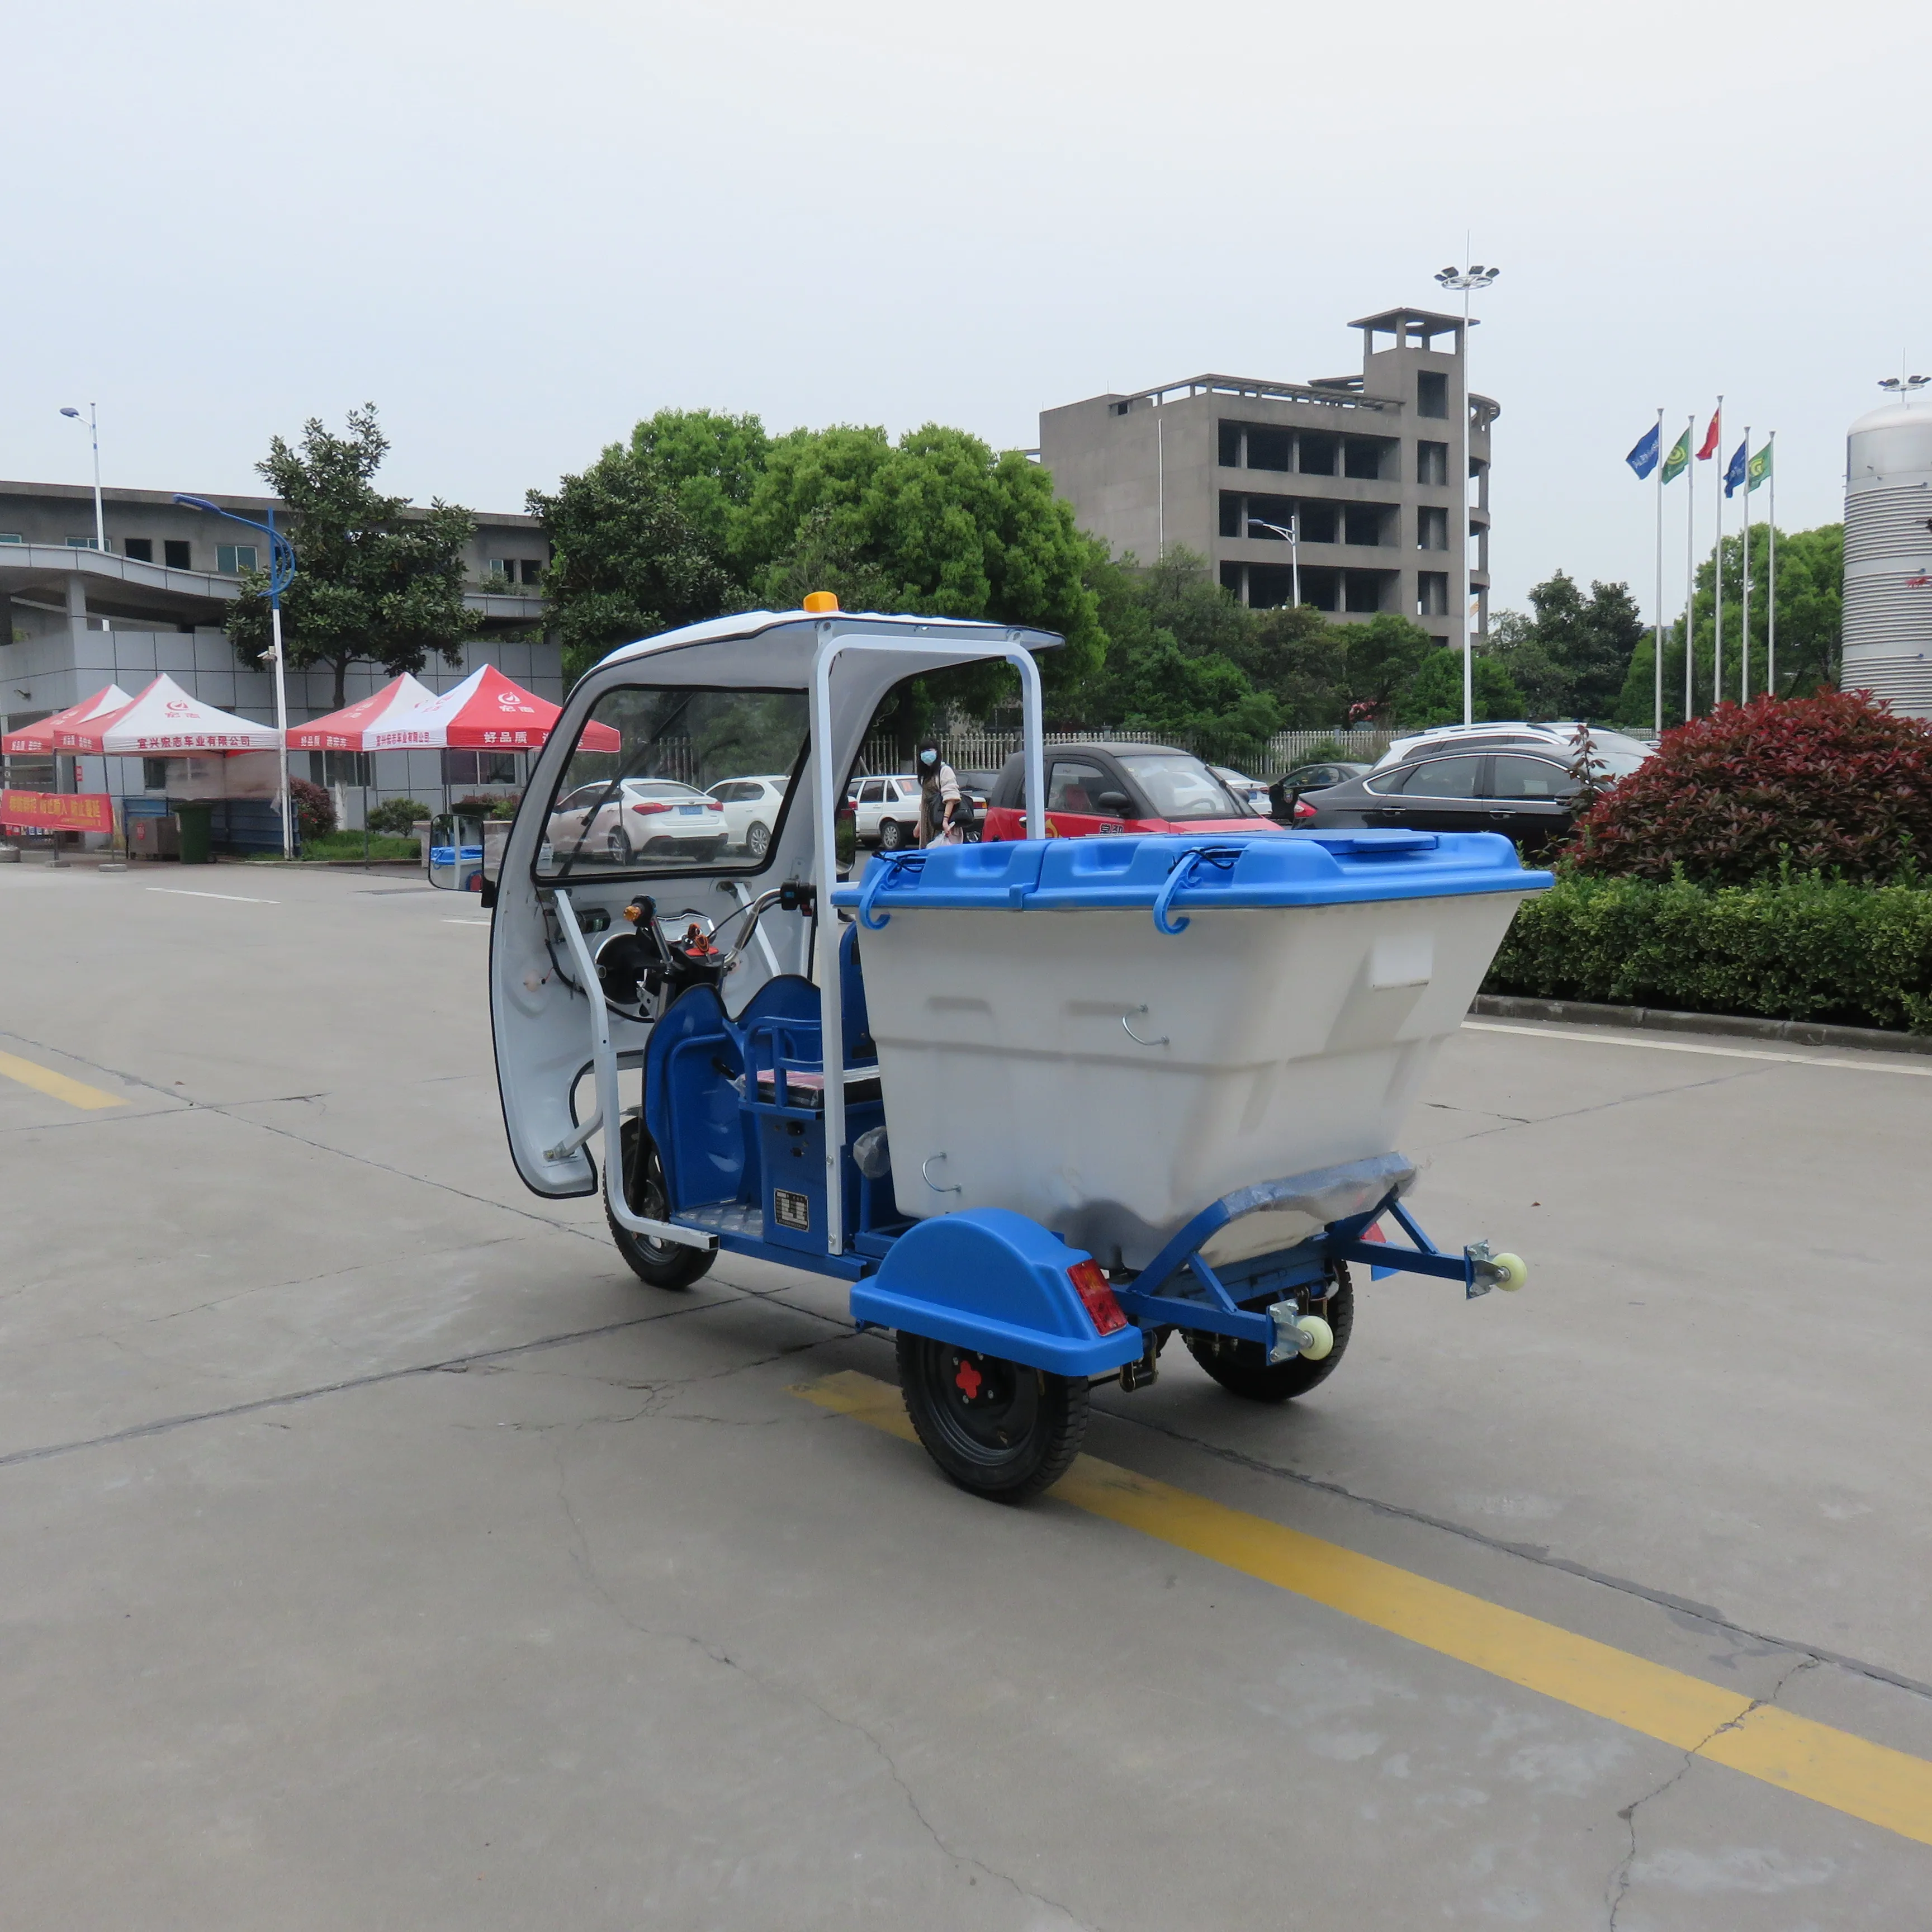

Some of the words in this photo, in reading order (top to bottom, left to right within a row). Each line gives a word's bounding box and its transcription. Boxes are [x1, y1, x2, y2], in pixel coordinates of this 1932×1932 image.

[138, 736, 250, 749] 宜兴宏志车业有限公司
[484, 731, 527, 744] 好品质
